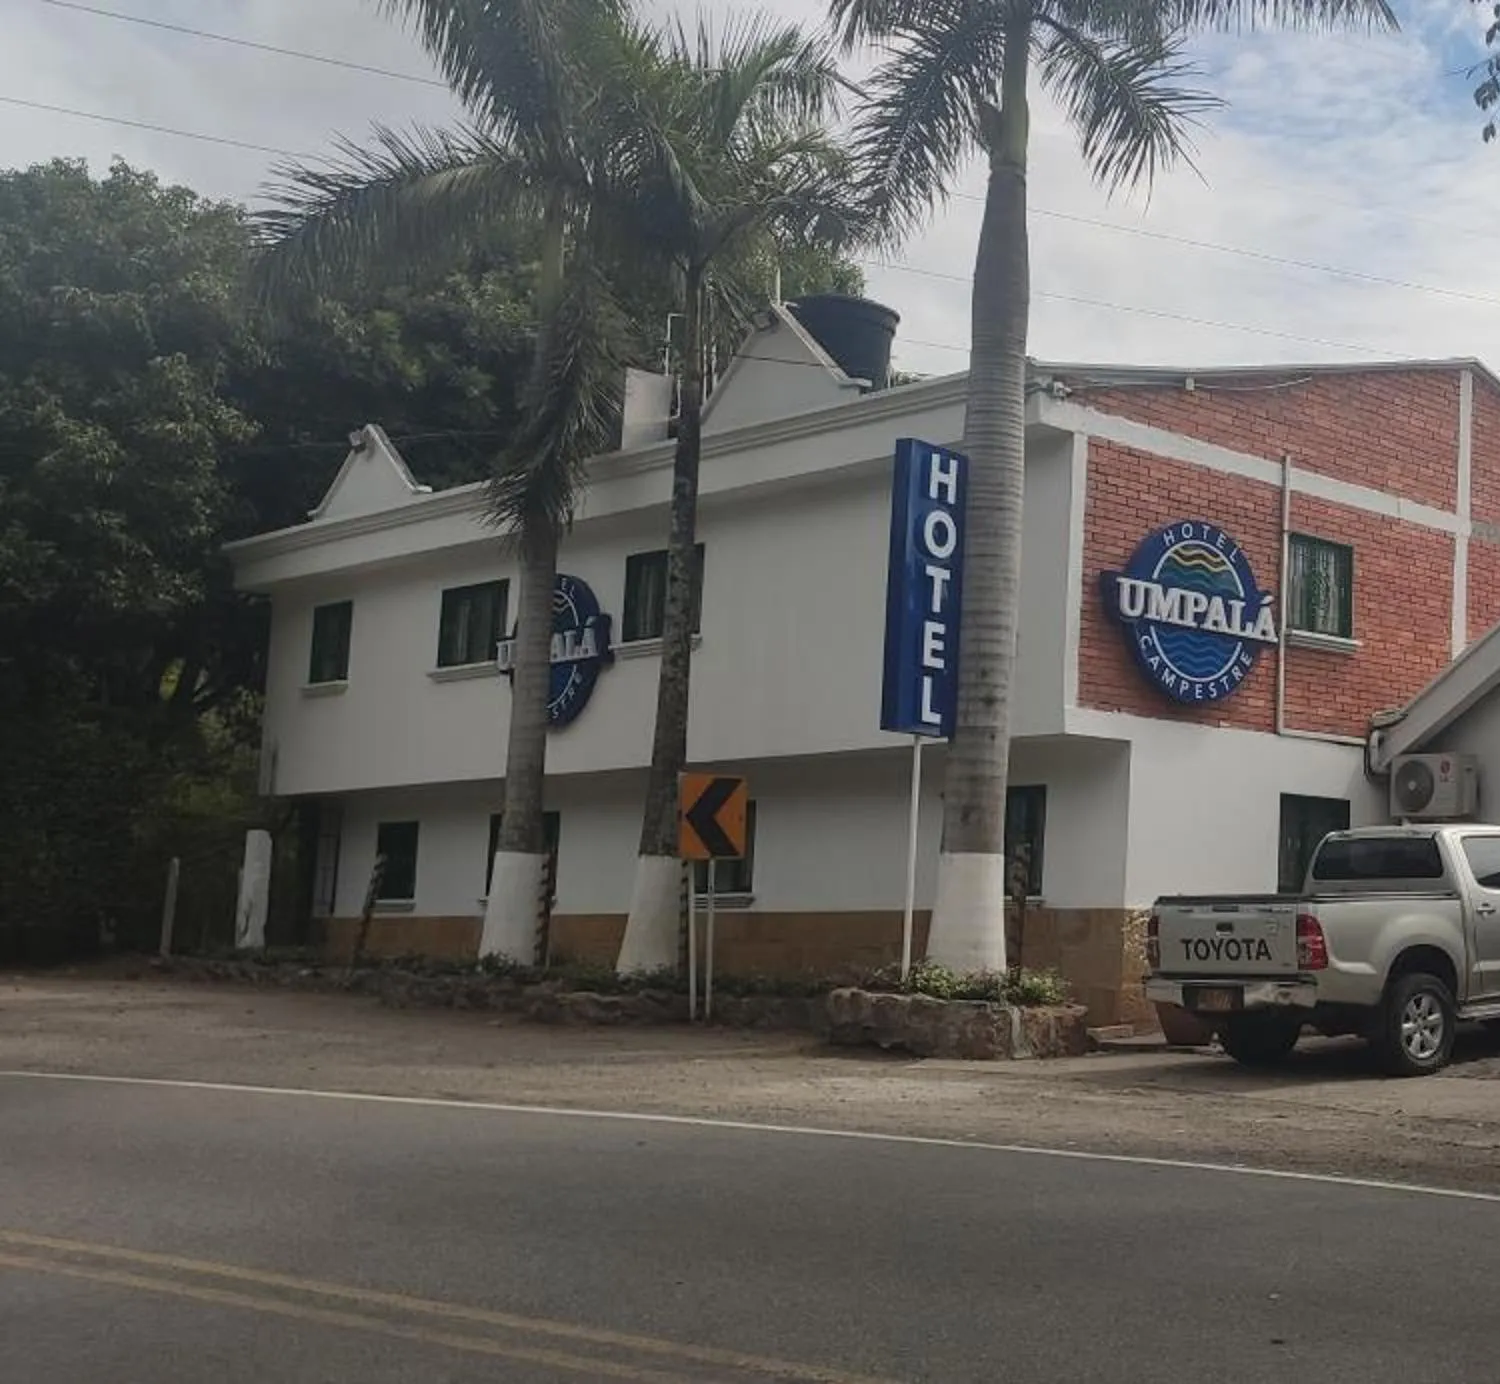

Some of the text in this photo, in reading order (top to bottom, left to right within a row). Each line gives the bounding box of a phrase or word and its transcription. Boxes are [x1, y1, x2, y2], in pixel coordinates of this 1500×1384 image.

[1163, 523, 1242, 563] HOTEL
[920, 453, 959, 725] HOTEL
[1116, 577, 1279, 643] UMPALÁ
[497, 615, 599, 670] UALÁ
[1140, 635, 1253, 699] CAMPESTRE
[1180, 938, 1273, 961] TOYOTA
